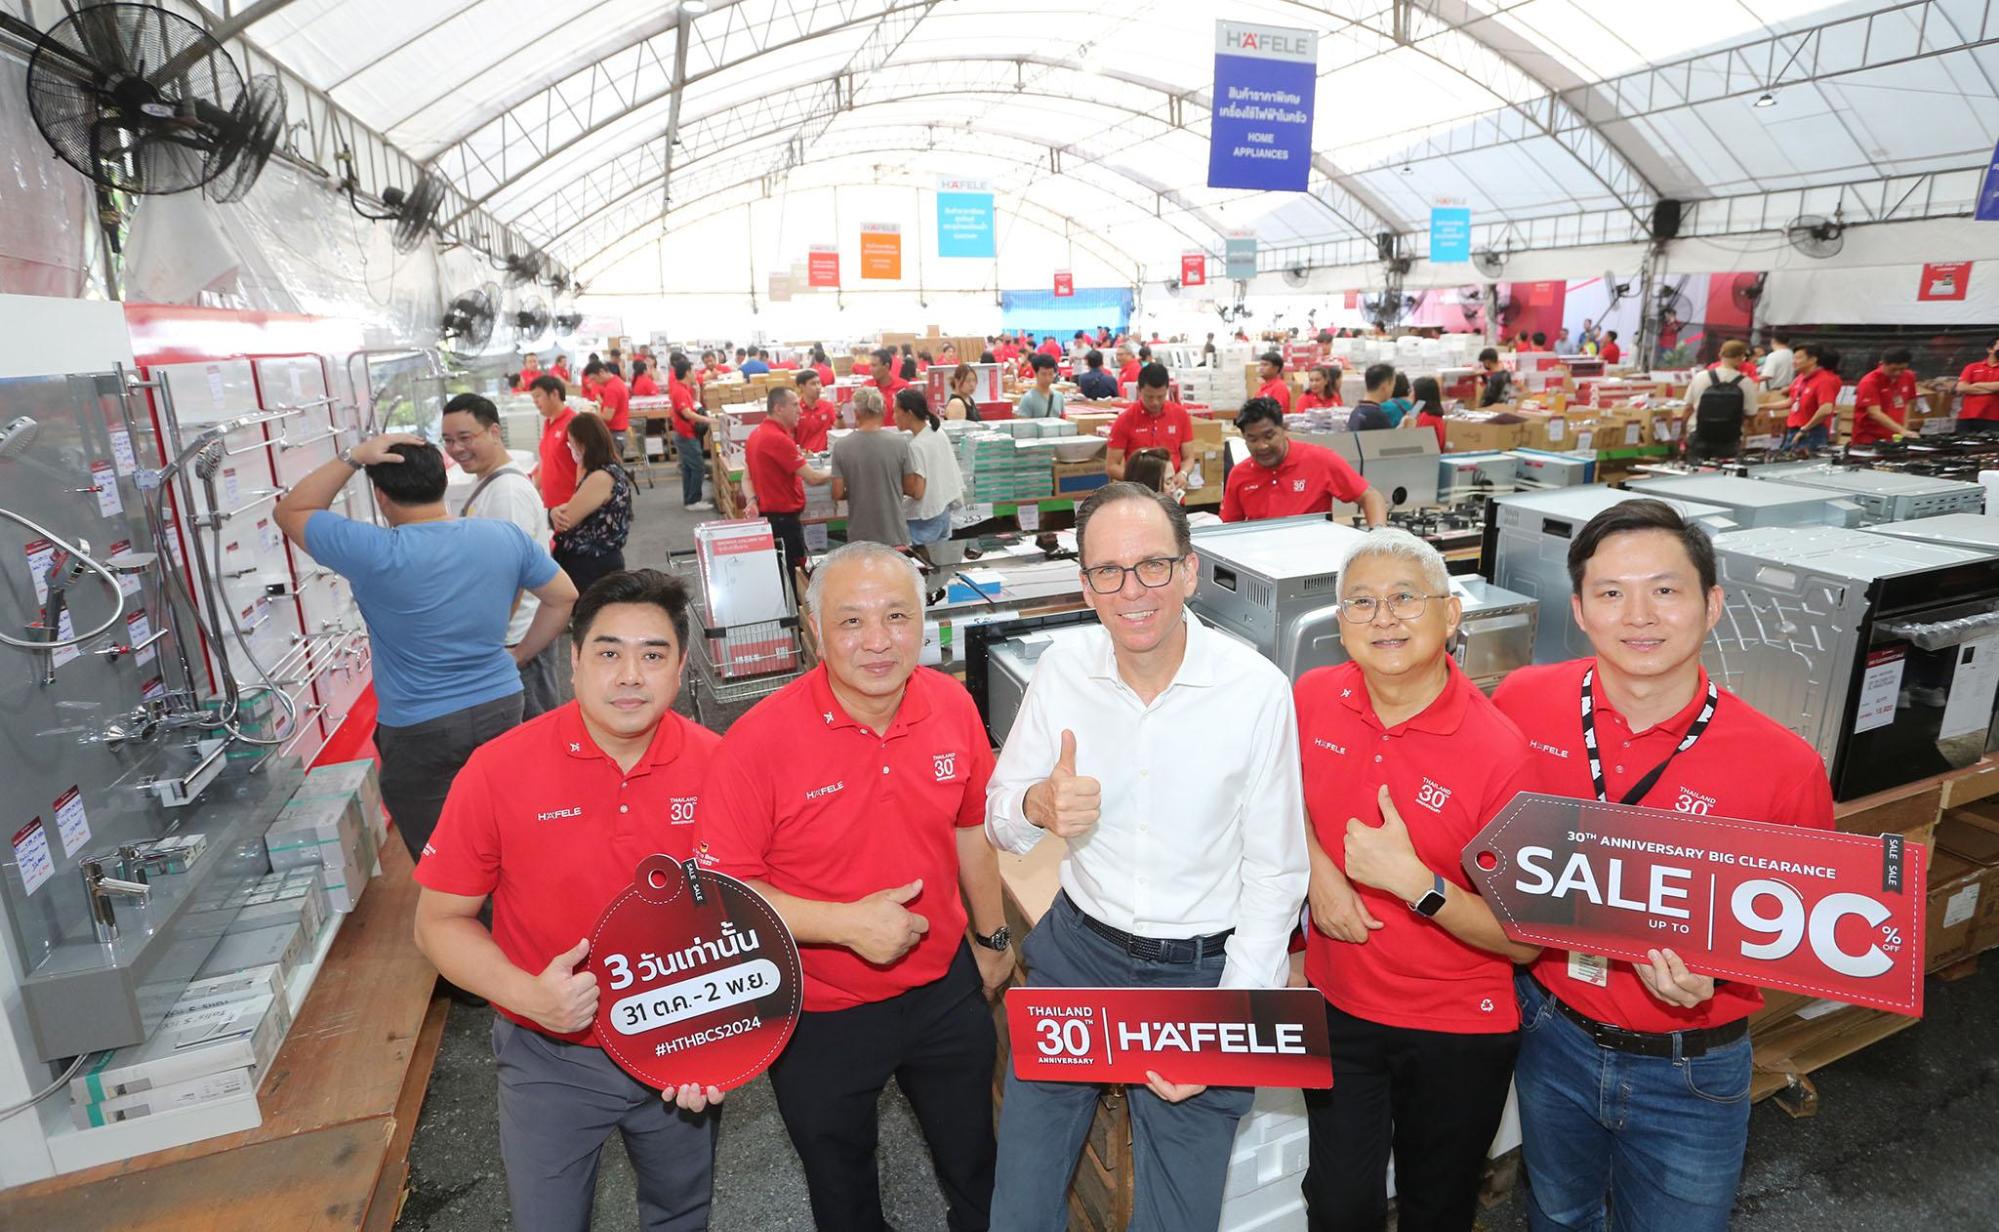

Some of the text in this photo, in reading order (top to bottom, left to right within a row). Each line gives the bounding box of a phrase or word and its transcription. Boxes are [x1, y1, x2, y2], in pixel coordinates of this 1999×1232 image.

[1226, 30, 1308, 55] HÄFELE
[1248, 132, 1274, 143] HOME
[1233, 147, 1289, 160] APPLIANCES
[1680, 786, 1716, 804] THAILAND
[1568, 831, 1837, 880] 30TH ANNIVERSARY BIG CLEARANCE
[1888, 839, 1898, 886] SALE SALE
[686, 863, 704, 902] SALE SALE
[1516, 846, 1692, 920] SALE
[1649, 919, 1690, 934] UP TO
[604, 921, 760, 990] 3 วันเท่านั้น
[1882, 943, 1900, 953] OFF
[623, 1003, 648, 1026] 31
[726, 972, 768, 996] พ.ย.
[1027, 1006, 1093, 1017] THAILAND
[655, 1016, 762, 1056] #HTHBCS2024
[1117, 1021, 1306, 1055] HÄFELE
[1038, 1057, 1094, 1065] ANNIVERSARY
